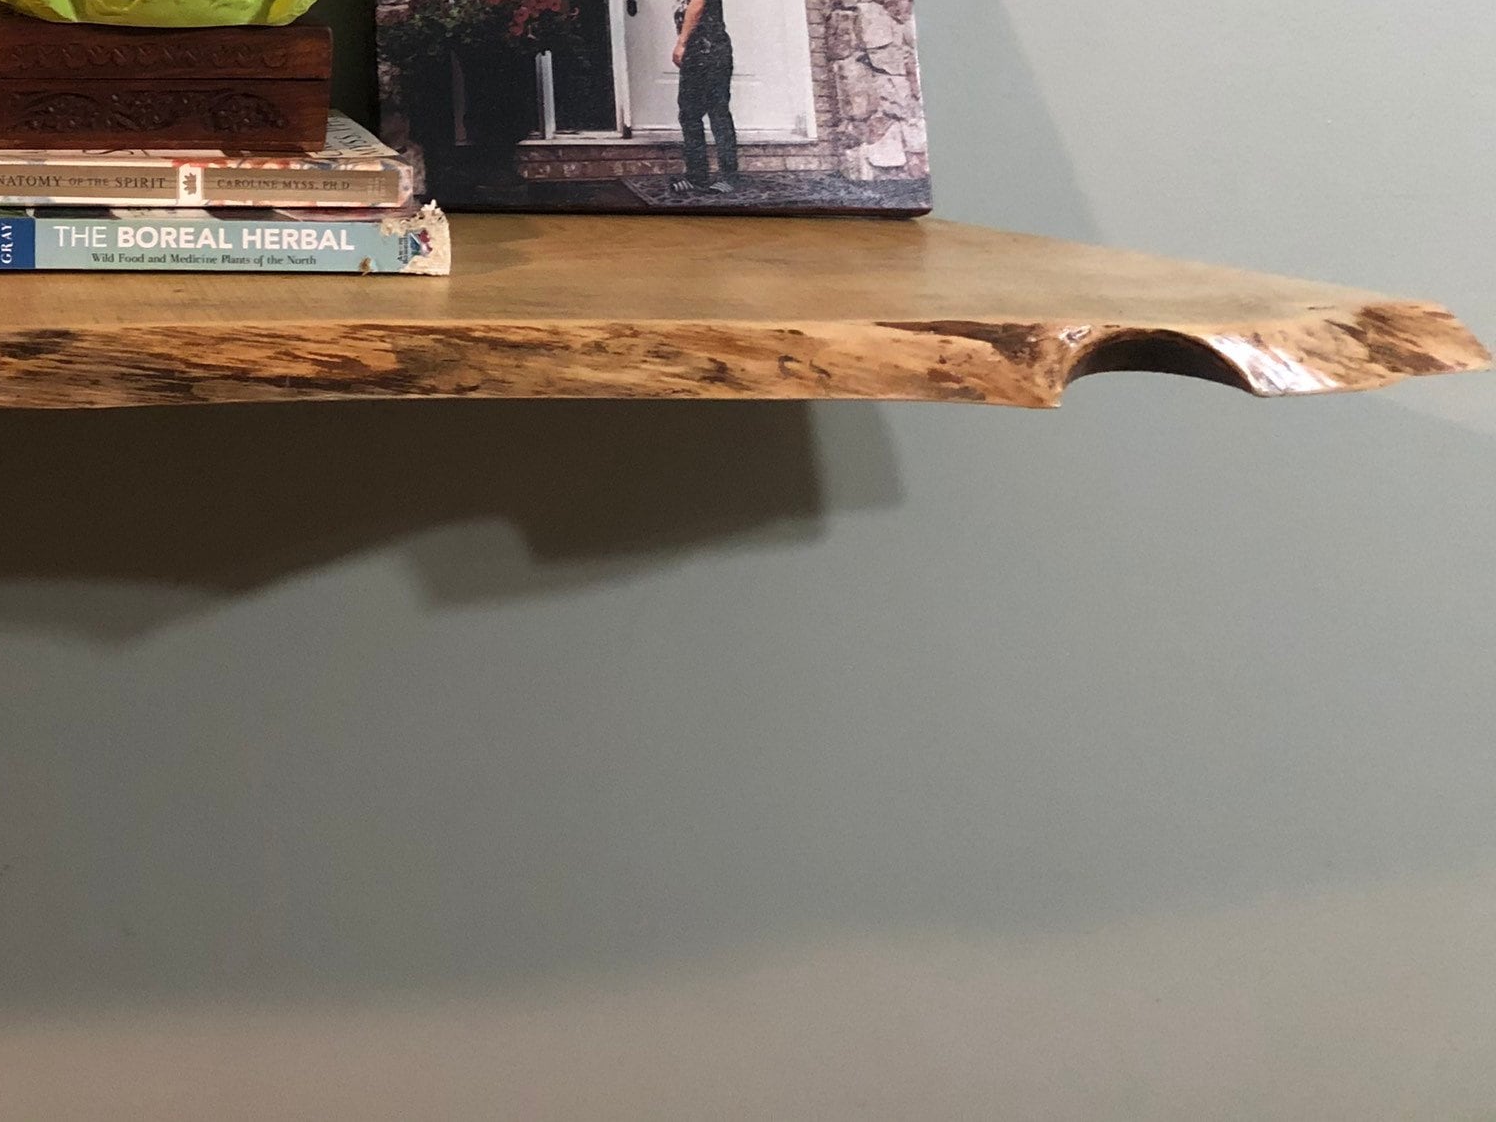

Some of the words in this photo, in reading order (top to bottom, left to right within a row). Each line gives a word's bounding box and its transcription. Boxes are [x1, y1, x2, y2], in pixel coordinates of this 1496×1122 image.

[68, 178, 83, 186] OF
[87, 178, 108, 186] THE
[115, 177, 165, 189] SPIRIT
[217, 179, 277, 189] CAROLINE
[0, 223, 14, 264] GRAY
[53, 225, 107, 247] THE
[117, 226, 233, 249] BOREAL
[242, 228, 355, 251] HERBAL
[92, 253, 114, 263] Wild
[118, 253, 144, 263] Food
[148, 254, 166, 263] and
[170, 254, 218, 264] Medicine
[221, 254, 250, 265] Plants
[254, 255, 264, 267] of
[267, 255, 284, 265] the
[288, 255, 317, 265] North
